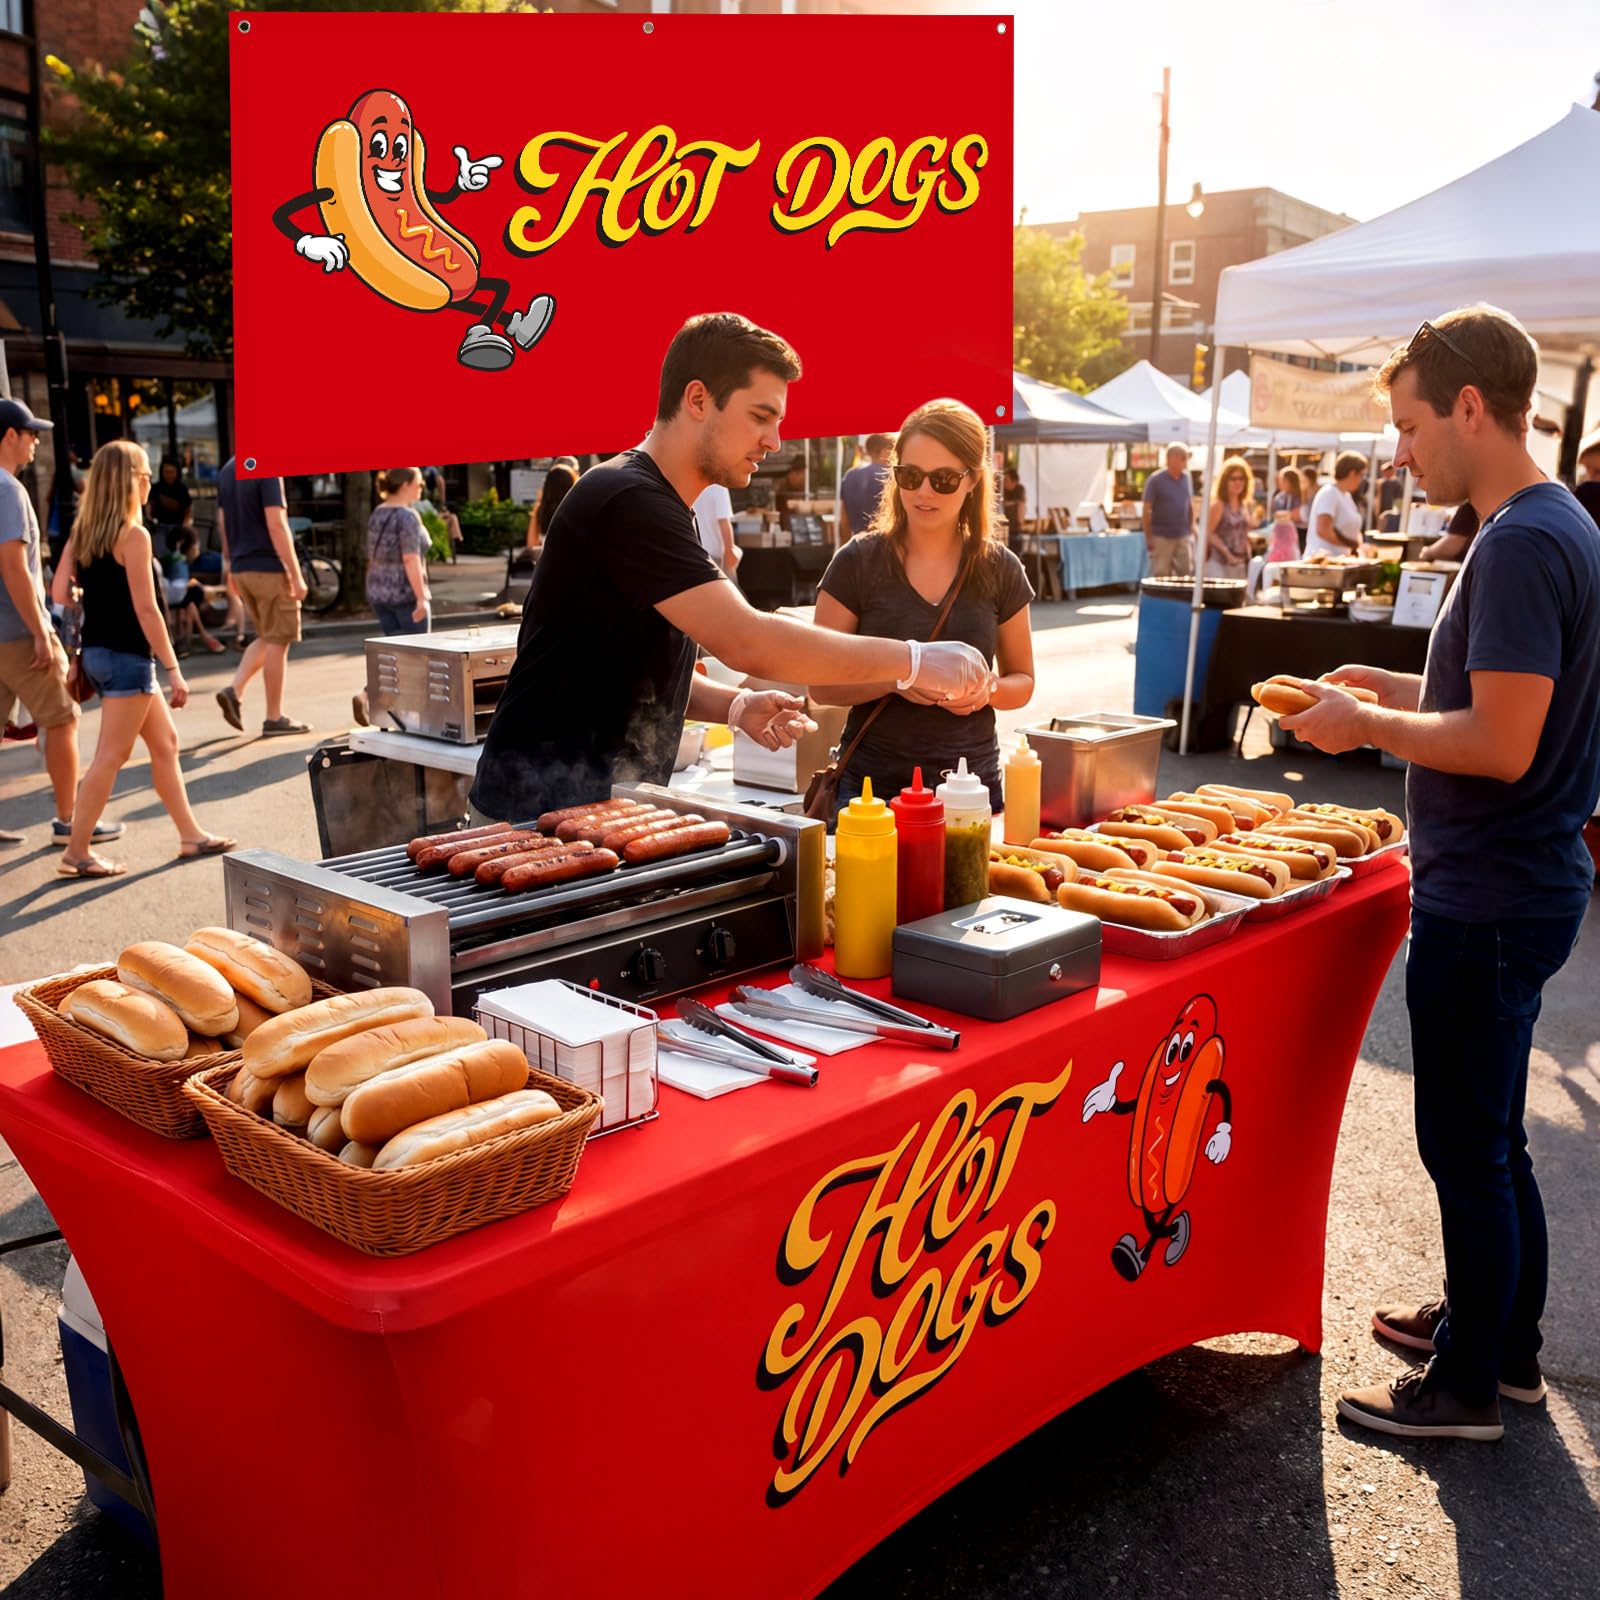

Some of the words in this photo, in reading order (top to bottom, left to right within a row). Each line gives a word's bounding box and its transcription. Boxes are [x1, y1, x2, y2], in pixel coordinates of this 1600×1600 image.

[503, 125, 761, 257] HOT
[770, 134, 989, 250] DOGS
[756, 1058, 1073, 1392] HOT
[766, 1200, 1057, 1509] DOGS
